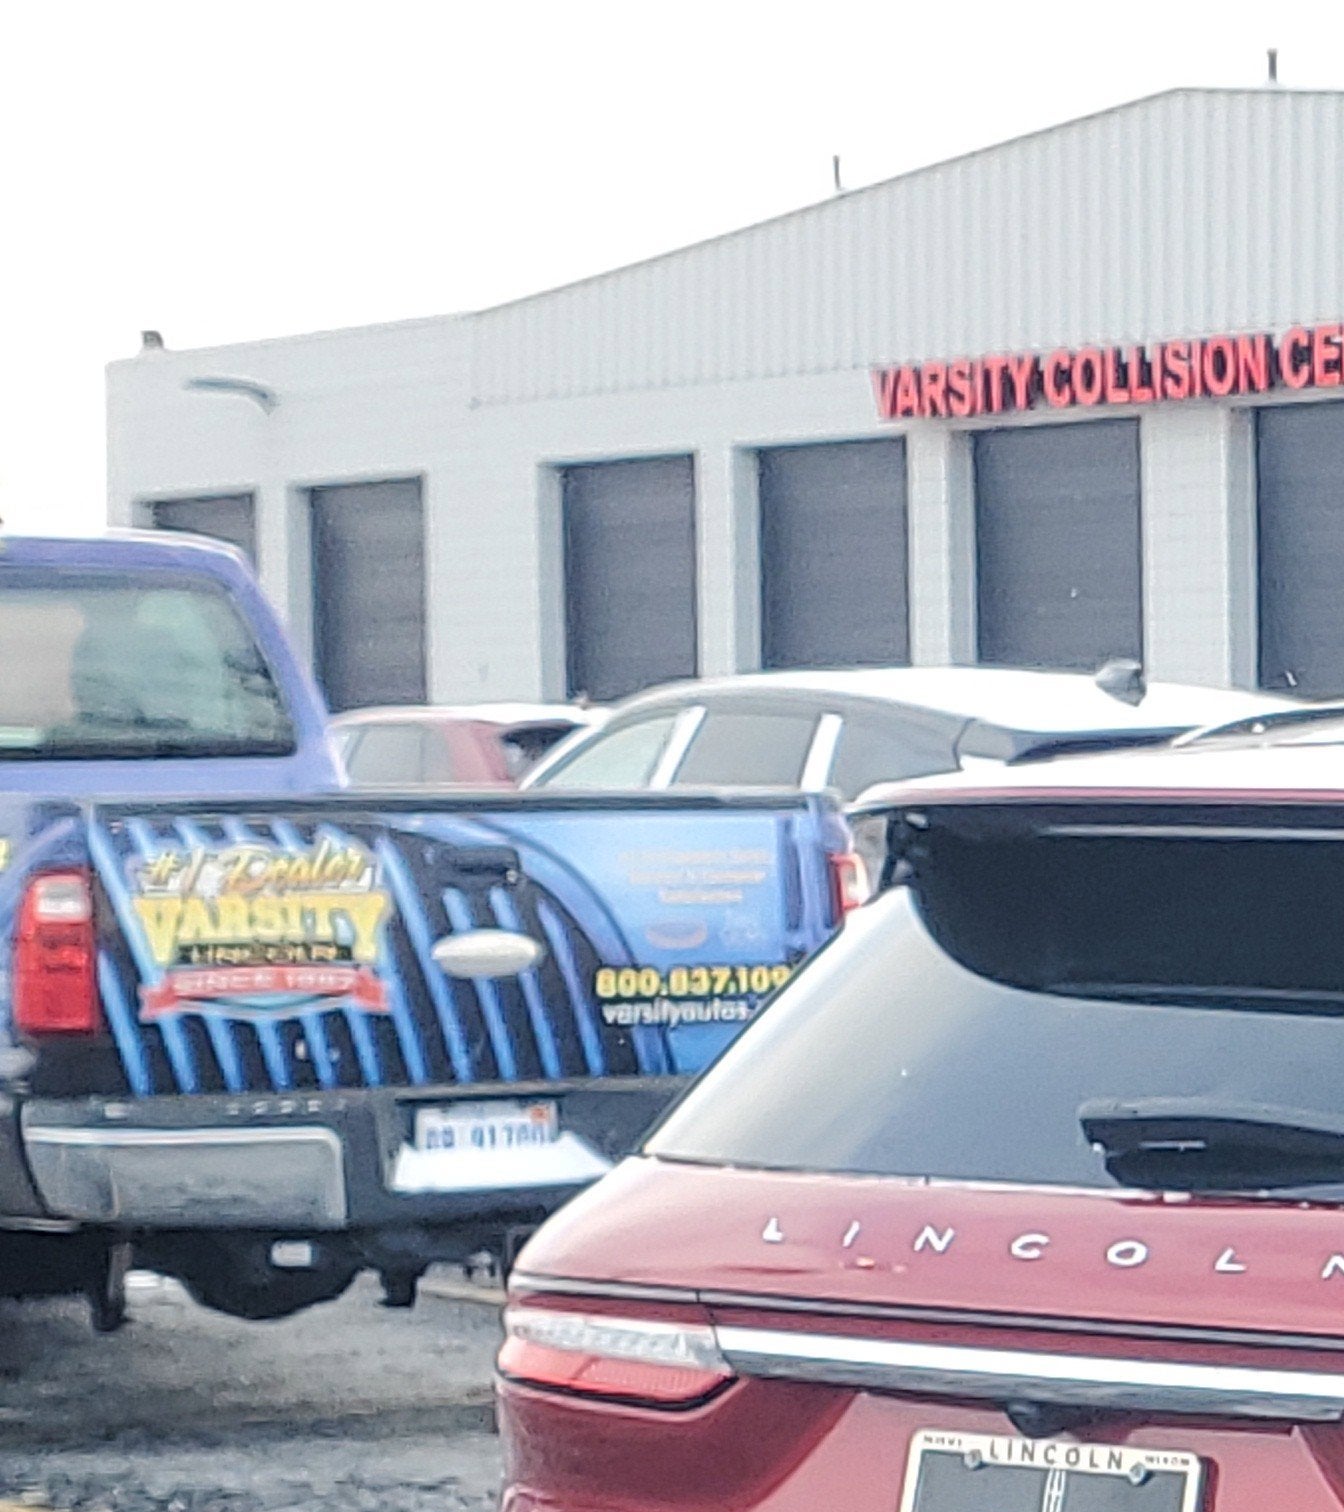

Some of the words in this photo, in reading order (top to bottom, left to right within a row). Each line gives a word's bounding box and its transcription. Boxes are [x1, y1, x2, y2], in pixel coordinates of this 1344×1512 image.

[871, 353, 1042, 420] VARSITY
[1043, 332, 1270, 406] COLLISION
[133, 893, 387, 964] VARSITY
[595, 965, 794, 998] 800.837.109
[602, 996, 758, 1028] varsityautos
[990, 1440, 1124, 1471] LINCOLN
